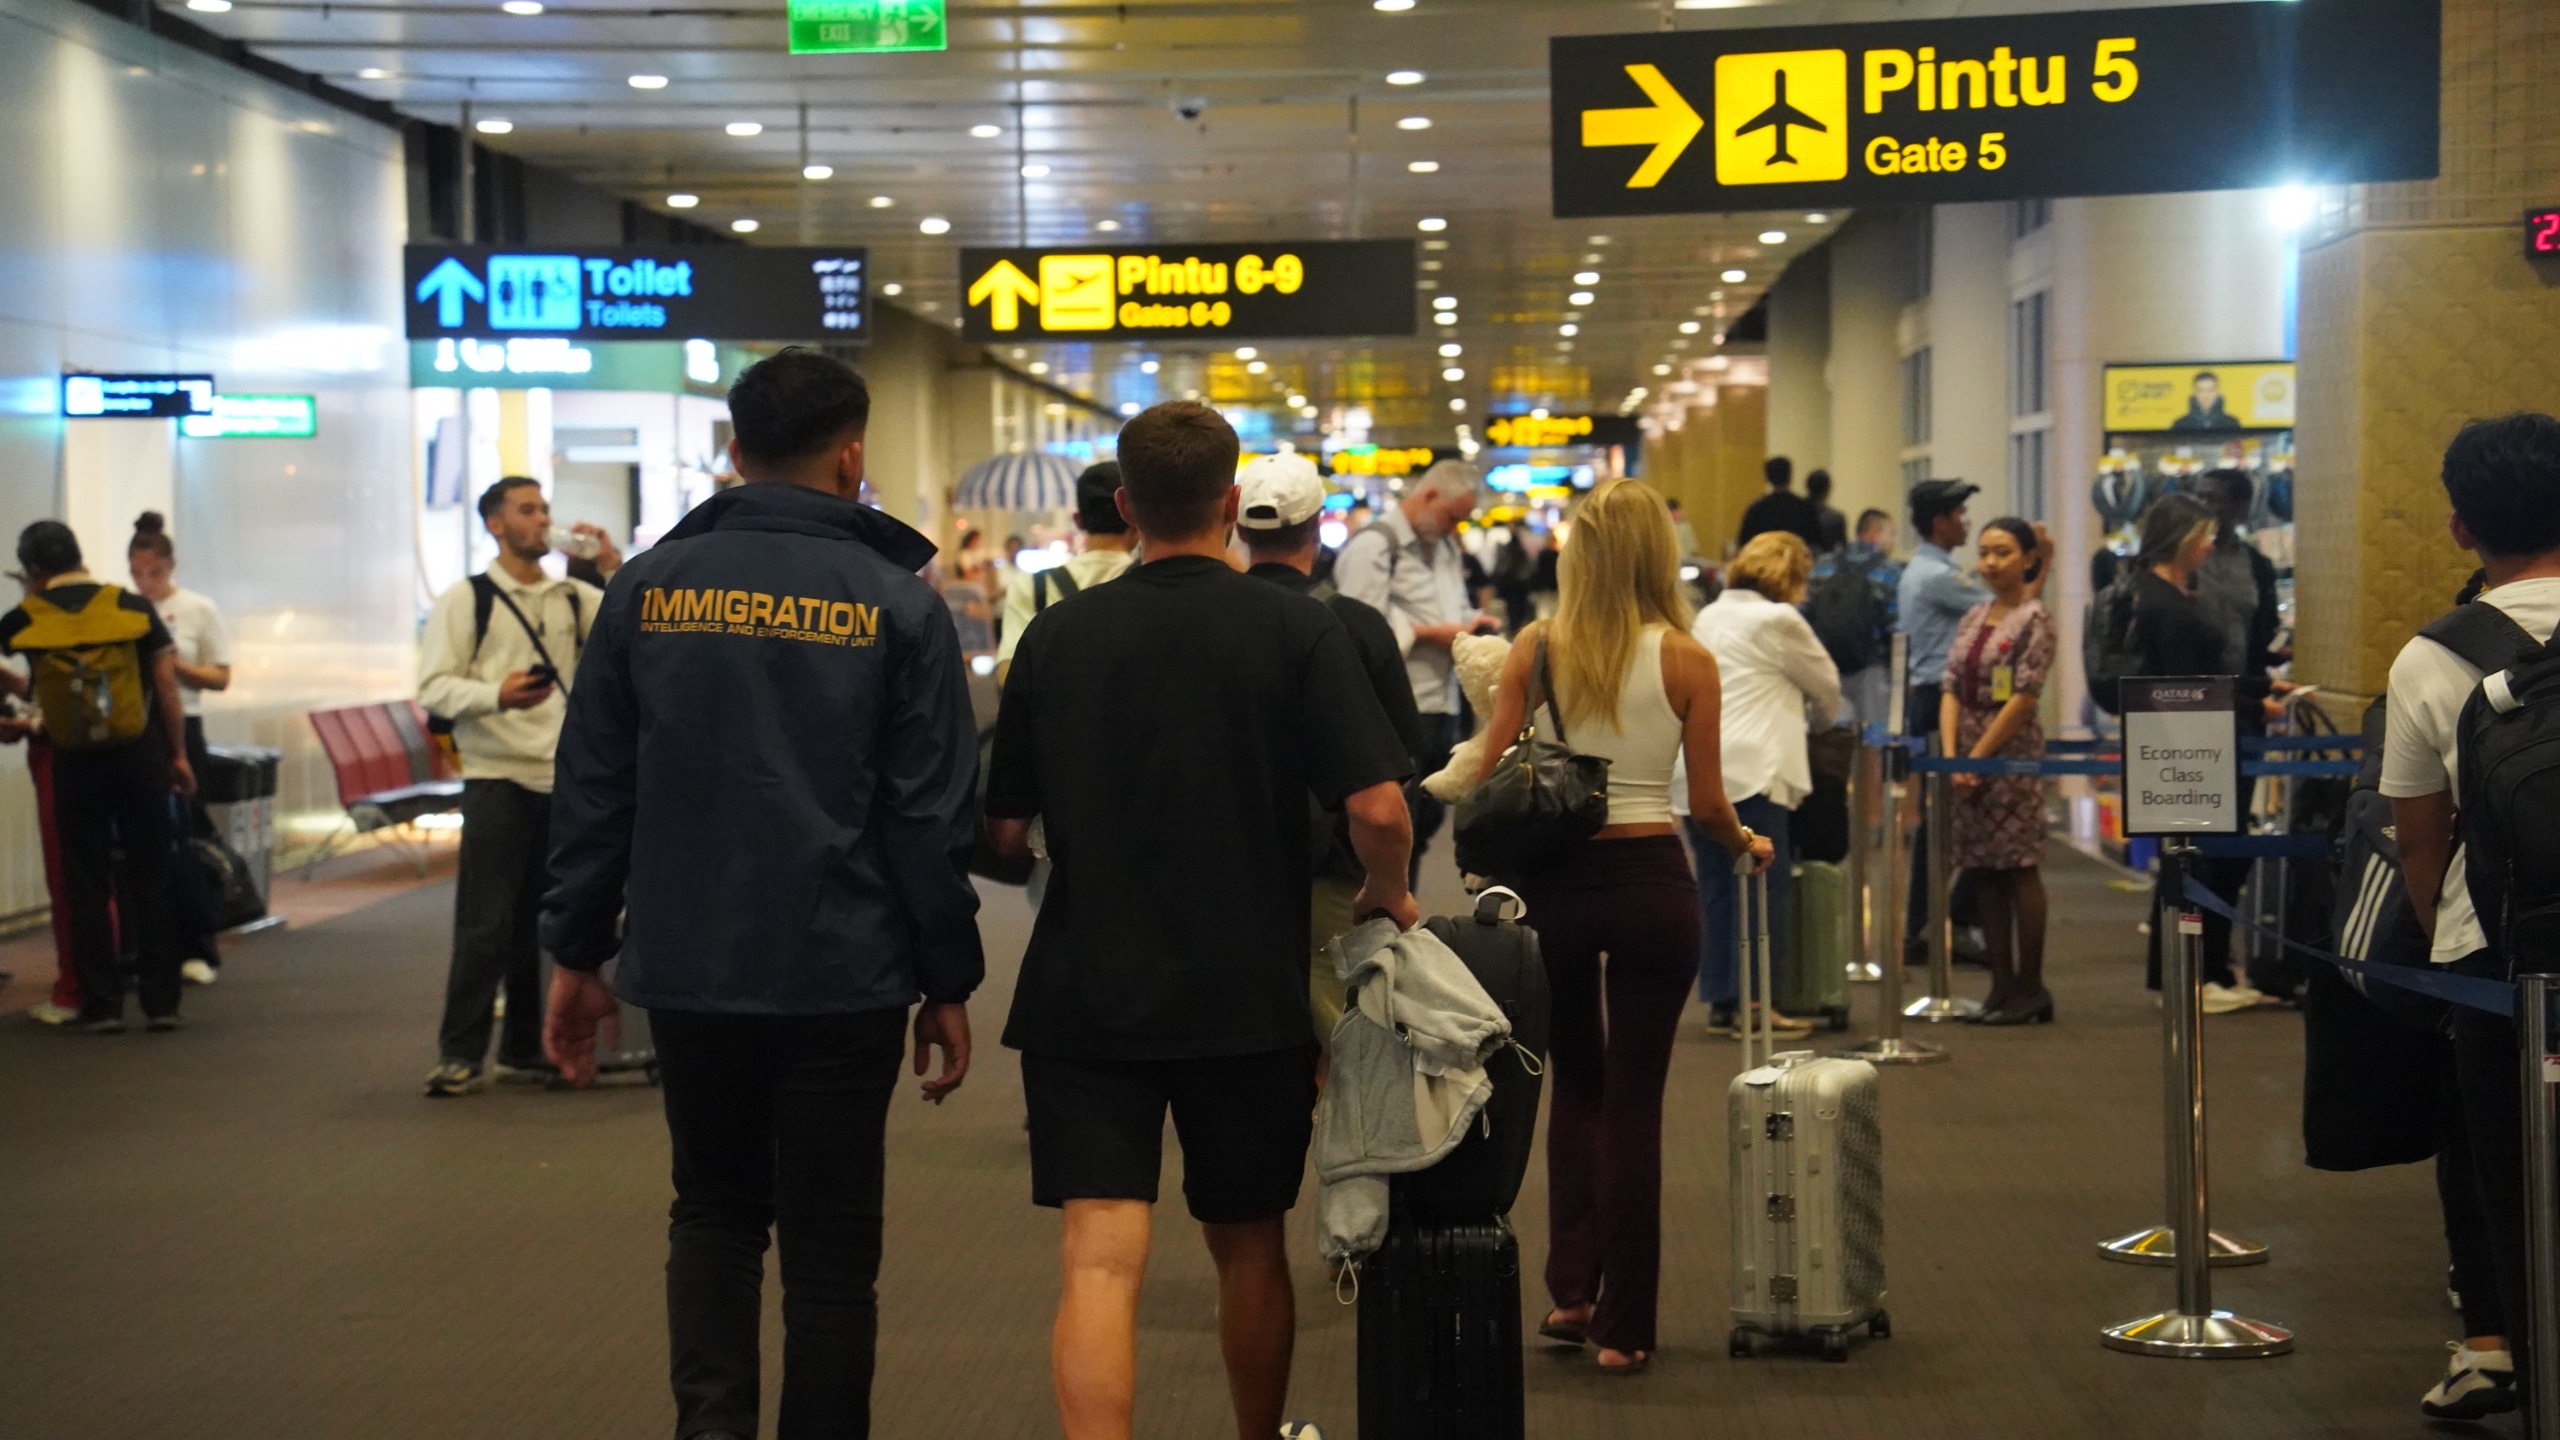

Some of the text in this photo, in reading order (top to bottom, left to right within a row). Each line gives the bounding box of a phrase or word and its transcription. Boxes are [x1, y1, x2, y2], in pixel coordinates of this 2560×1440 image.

[819, 24, 850, 42] EXIT
[1864, 37, 2139, 114] Pintu 5
[1864, 132, 2007, 175] Gate 5
[583, 258, 693, 296] Toilet
[1117, 254, 1303, 295] Pintu 6-9
[585, 300, 667, 328] Toilets
[1118, 301, 1231, 328] Gates 6-9
[641, 587, 879, 636] IMMIGRATION
[640, 622, 876, 647] INTELLIGENCE AND ENFORCEMENT UNIT
[2152, 689, 2190, 700] QATAR
[2140, 745, 2223, 764] Economy
[2160, 767, 2204, 783] Class
[2142, 790, 2222, 808] Boarding
